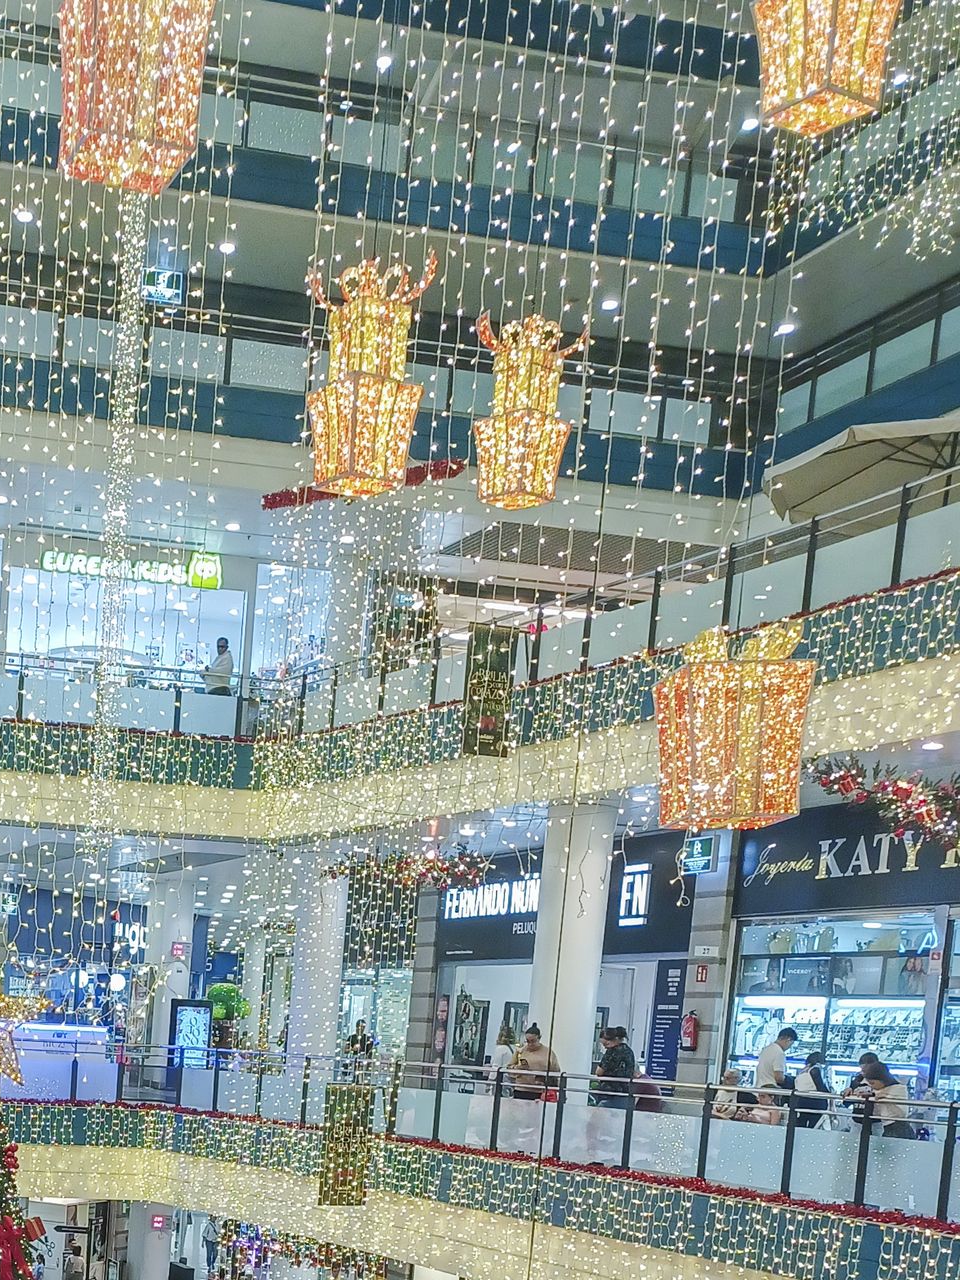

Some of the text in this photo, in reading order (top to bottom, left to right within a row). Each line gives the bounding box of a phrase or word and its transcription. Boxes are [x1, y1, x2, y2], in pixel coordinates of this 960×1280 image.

[814, 830, 925, 880] KATY
[444, 880, 509, 919] FERNANDO
[620, 873, 650, 915] FN
